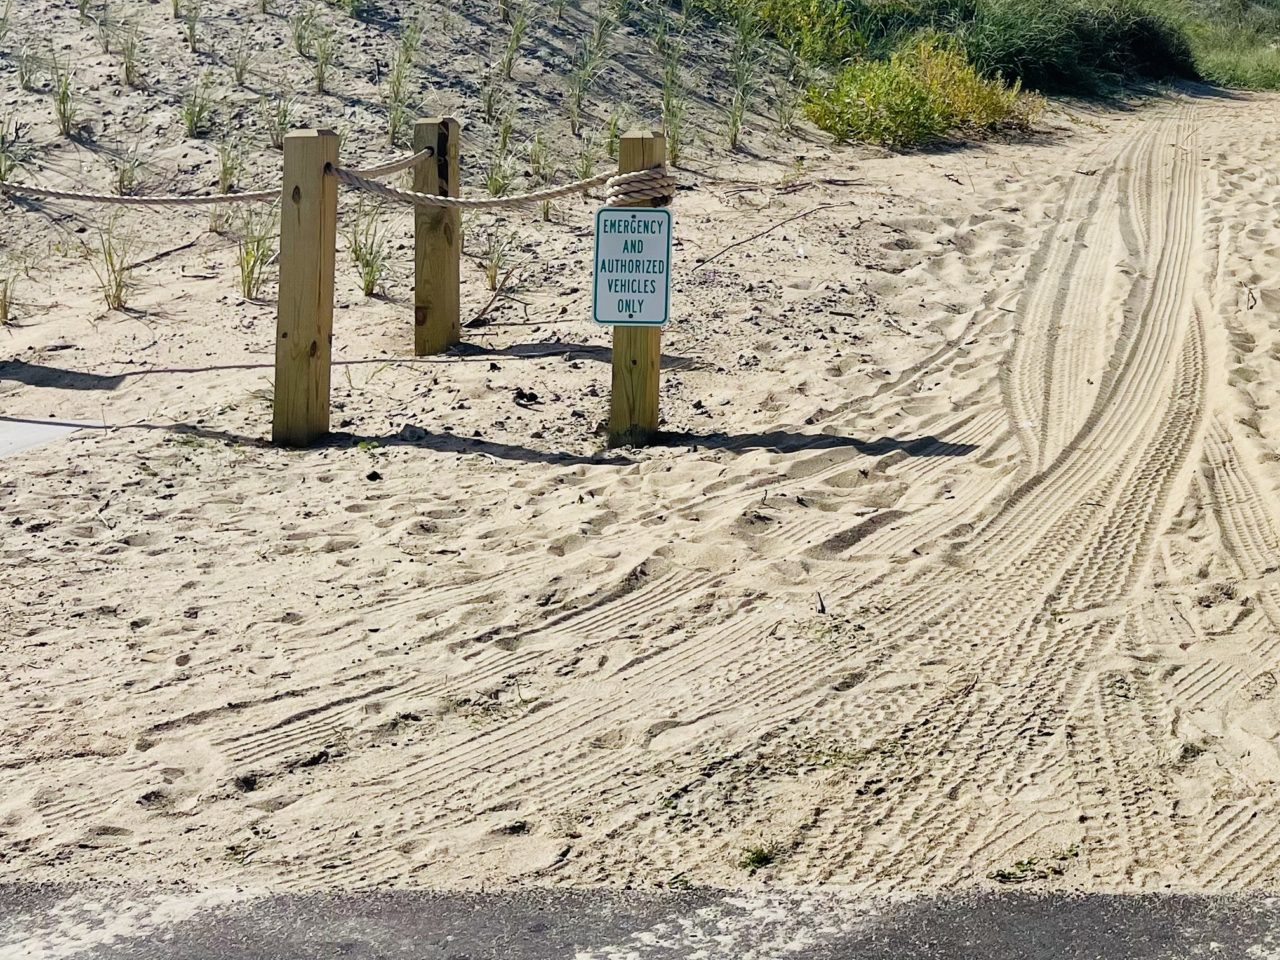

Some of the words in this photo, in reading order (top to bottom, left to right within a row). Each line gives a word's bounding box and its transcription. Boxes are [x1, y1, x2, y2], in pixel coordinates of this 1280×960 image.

[603, 219, 664, 234] EMERGENCY
[622, 239, 644, 254] AND
[600, 259, 665, 274] AUTHORIZED
[607, 279, 656, 294] VEHICLES
[617, 299, 645, 313] ONLY
